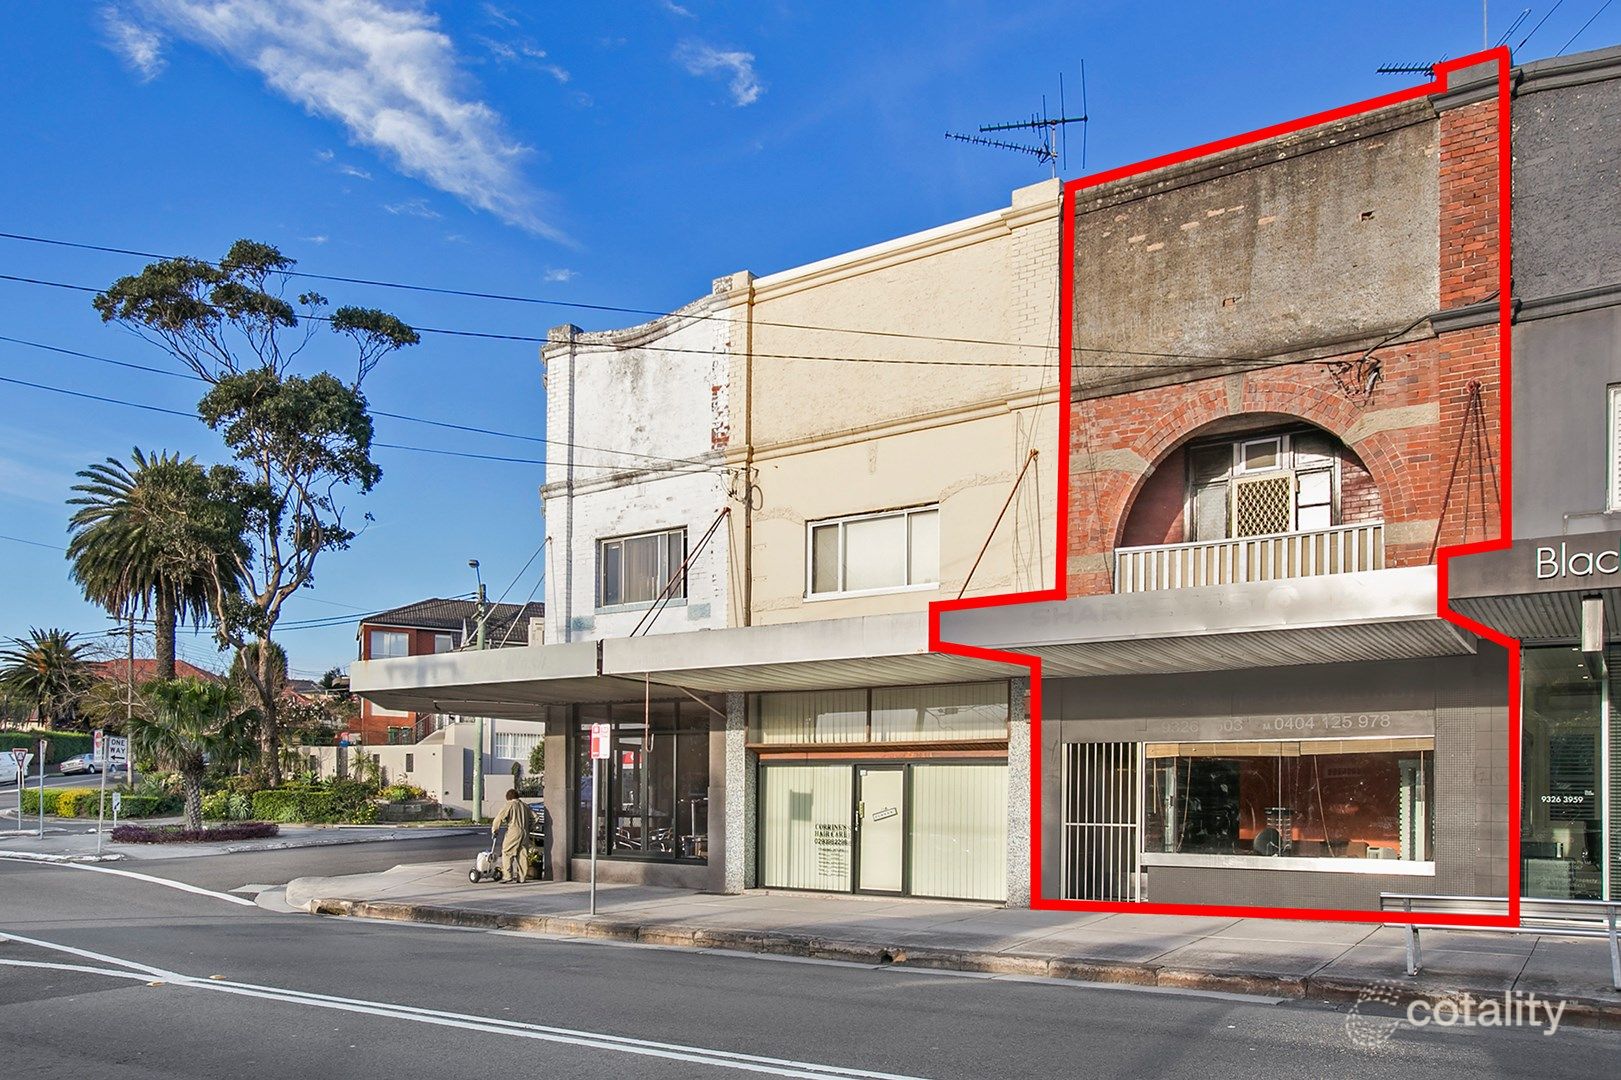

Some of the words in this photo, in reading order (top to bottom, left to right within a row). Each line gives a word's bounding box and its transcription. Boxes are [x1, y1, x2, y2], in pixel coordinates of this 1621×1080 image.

[1537, 542, 1619, 579] Blac
[1274, 717, 1315, 730] 0404
[1322, 715, 1353, 729] 125
[1358, 714, 1391, 728] 978
[111, 738, 125, 746] ONE
[1541, 795, 1561, 803] 9326
